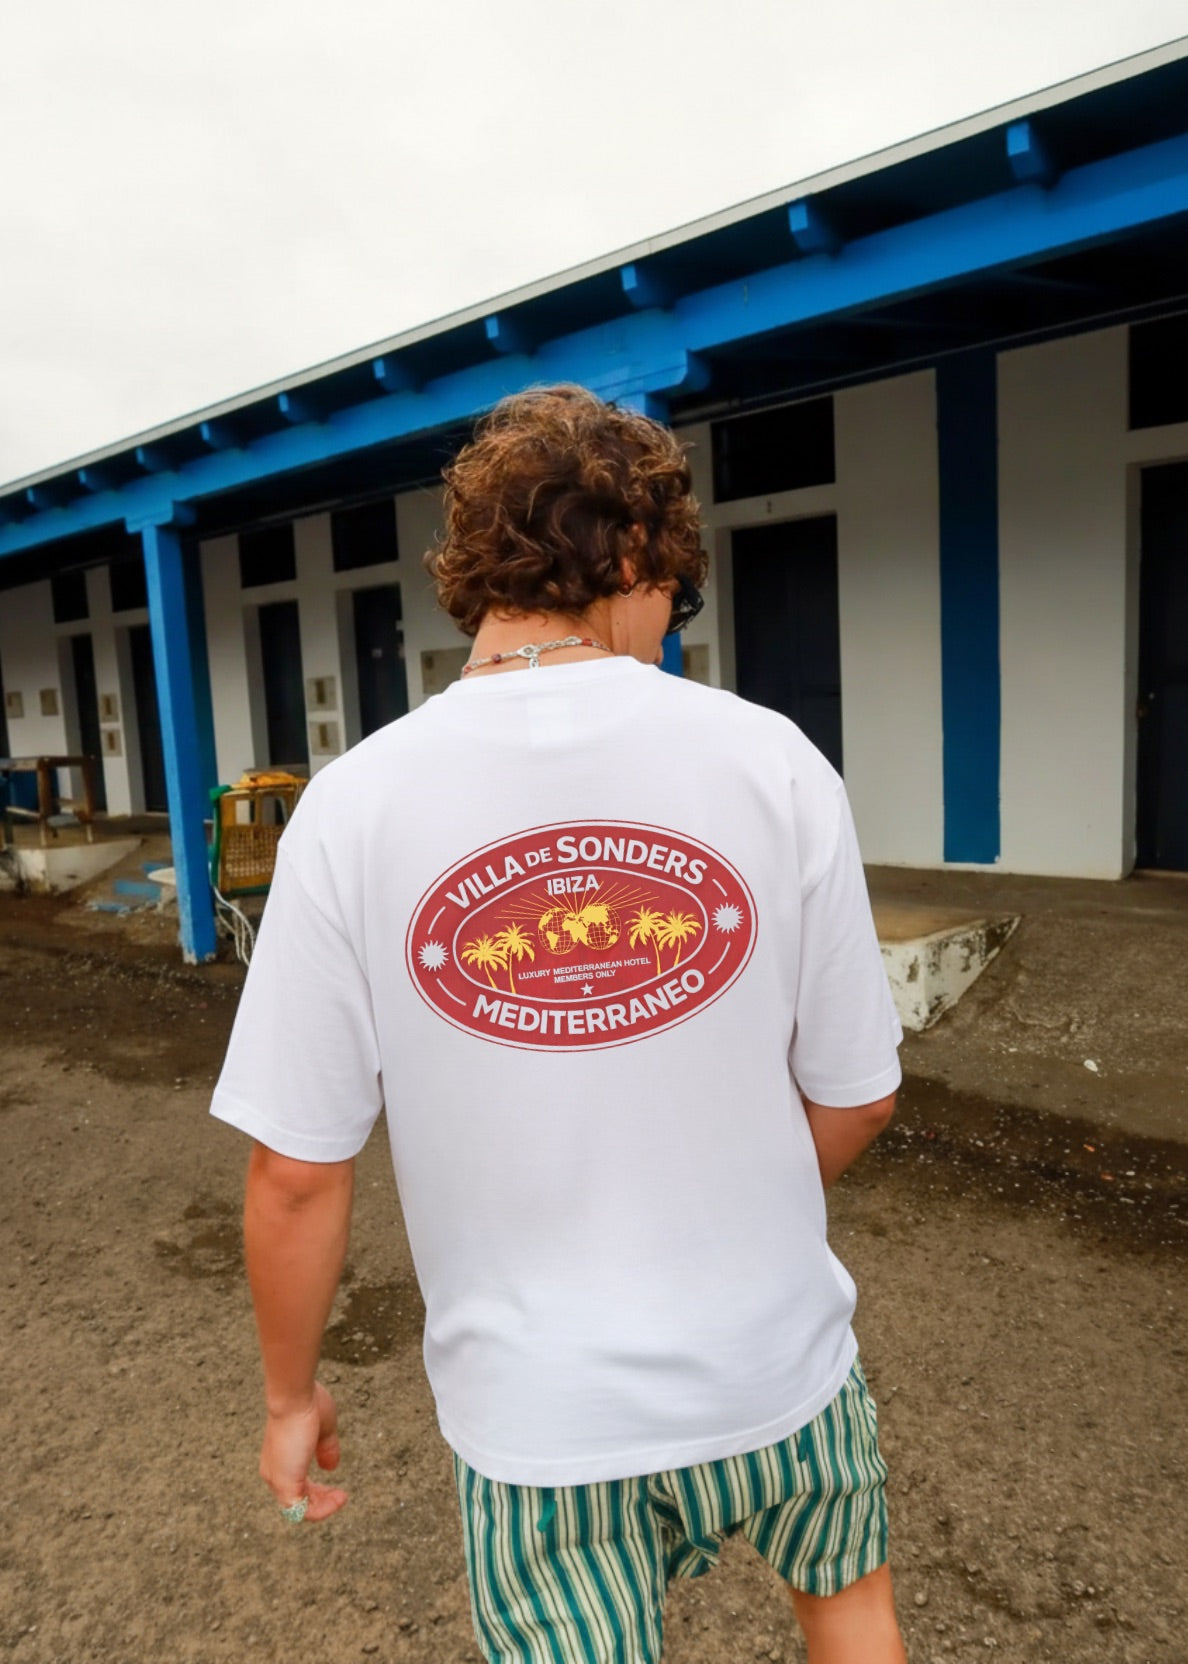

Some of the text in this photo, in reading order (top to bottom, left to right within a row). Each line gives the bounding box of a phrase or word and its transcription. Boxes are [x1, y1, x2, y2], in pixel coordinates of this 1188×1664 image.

[446, 836, 707, 908] VILLA DE SONDERS
[547, 874, 600, 895] IBIZA
[518, 957, 651, 979] LUXURY MEDITERRANEAN HOTEL
[554, 970, 616, 983] MEMBERS ONLY
[473, 969, 705, 1035] MEDITERRANEO
